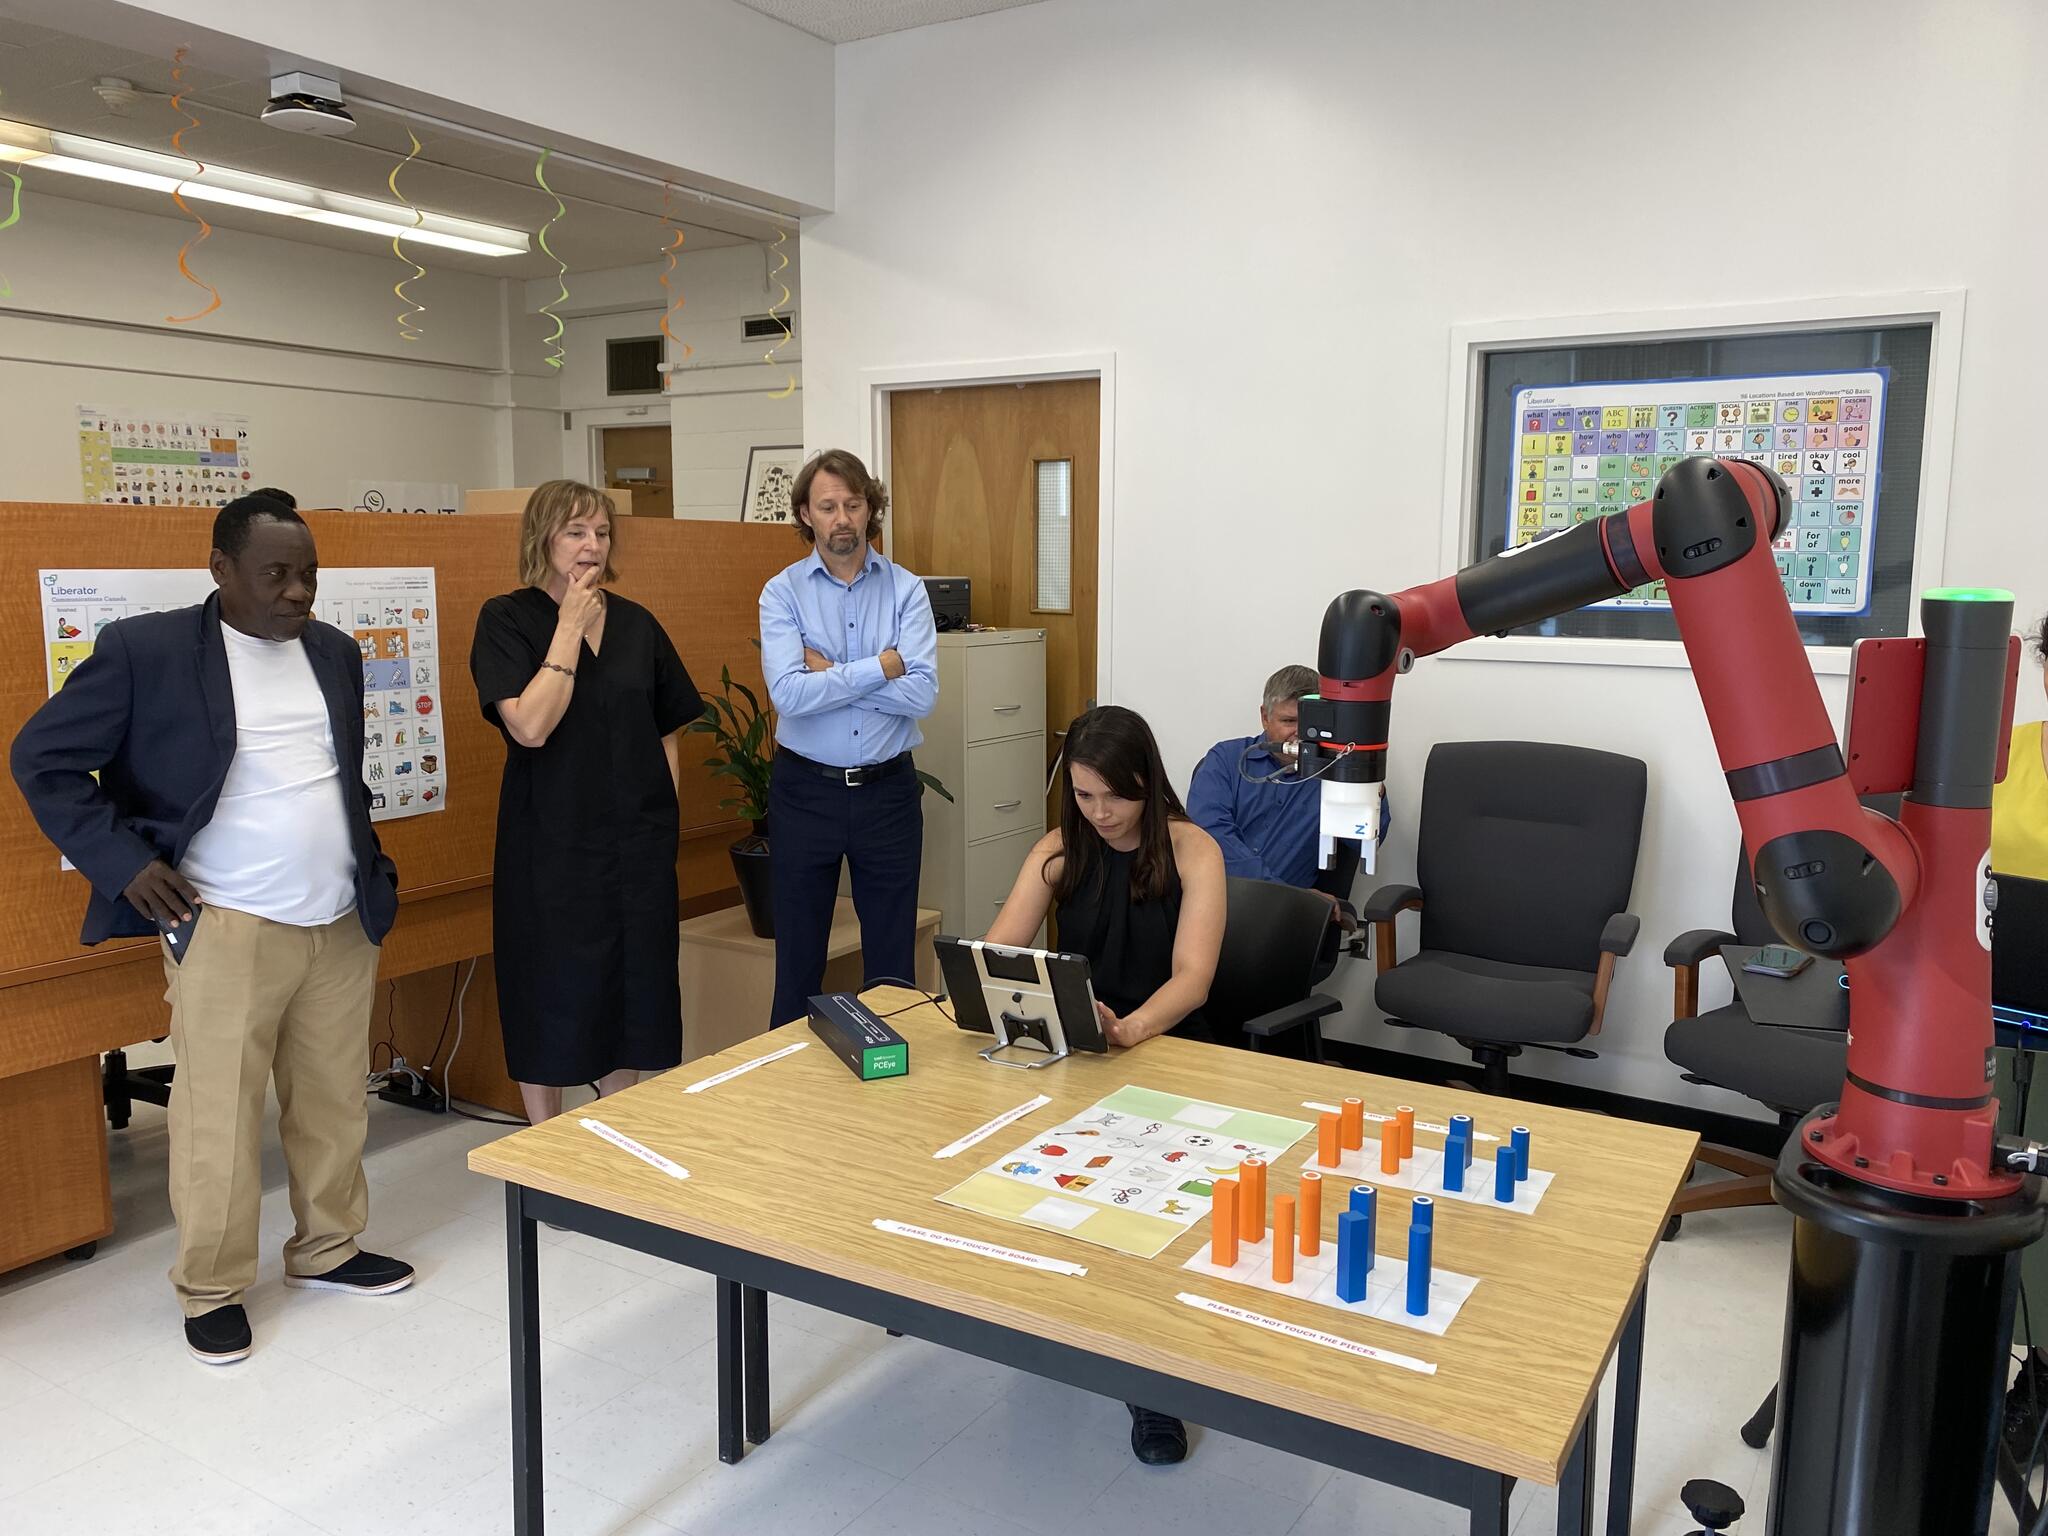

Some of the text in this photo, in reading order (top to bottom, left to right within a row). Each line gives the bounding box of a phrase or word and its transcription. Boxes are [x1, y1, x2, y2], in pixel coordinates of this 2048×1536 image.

[51, 587, 97, 596] Liberator
[874, 1061, 896, 1070] PCEye
[962, 1241, 989, 1251] TOUCH
[1208, 1302, 1243, 1317] PLEASE,
[1262, 1319, 1282, 1327] NOT
[1284, 1325, 1316, 1338] TOUCH
[1319, 1336, 1338, 1344] THE
[1340, 1342, 1377, 1357] PIECES.
